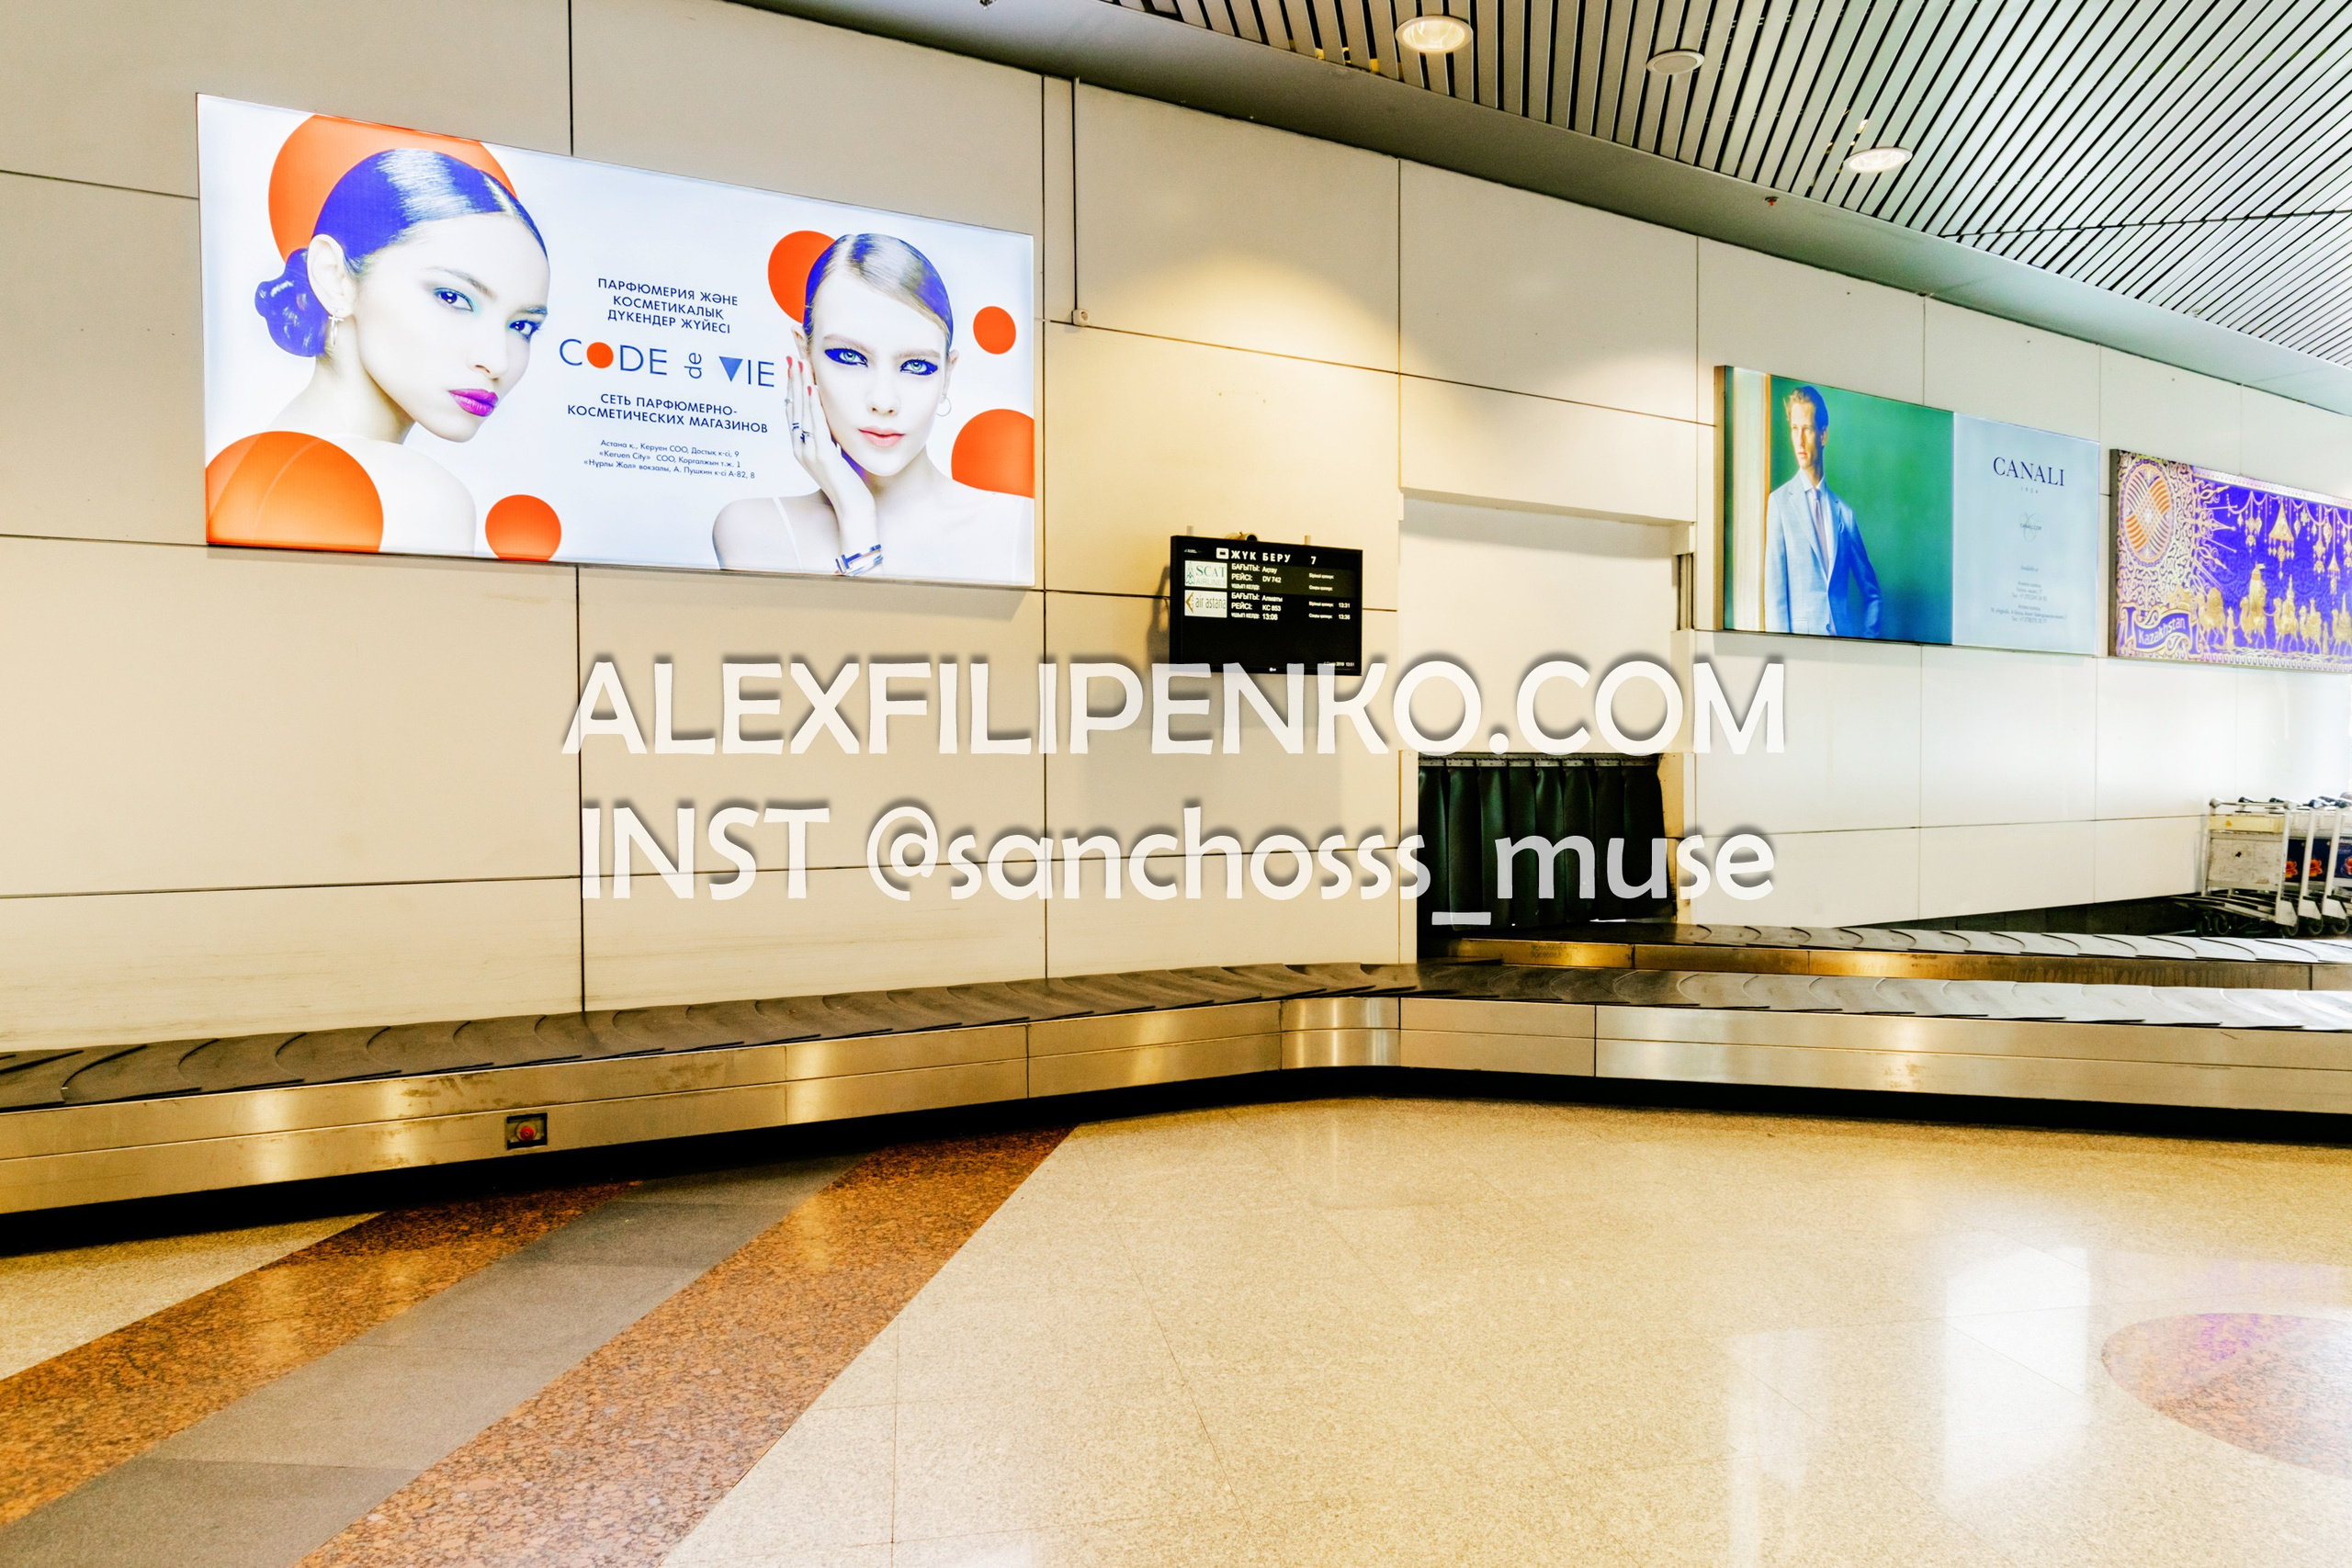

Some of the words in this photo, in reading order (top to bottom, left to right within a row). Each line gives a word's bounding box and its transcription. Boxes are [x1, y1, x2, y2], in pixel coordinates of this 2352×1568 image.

[598, 278, 695, 300] ПАРФЮМЕРИЯ
[700, 291, 739, 306] ЖӘНЕ
[613, 296, 724, 320] КОСМЕТИКАЛЫҚ
[607, 310, 676, 327] ДҮКЕНДЕР
[681, 318, 730, 333] ЖҮЙЕСІ
[600, 393, 631, 406] СЕТЬ
[636, 397, 738, 416] ПАРФЮМЕРНО-
[567, 404, 684, 425] КОСМЕТИЧЕСКИХ
[689, 416, 768, 434] МАГАЗИНОВ
[601, 439, 628, 448] Астана
[640, 443, 668, 452] Керуен
[691, 446, 717, 457] Достық
[684, 466, 713, 476] Пушкин
[1993, 457, 2064, 487] CANALI
[1231, 550, 1257, 561] ЖҮК
[1262, 552, 1291, 563] БЕРУ
[1310, 556, 1317, 565] 7
[1195, 564, 1227, 578] SCAT
[1195, 594, 1204, 609] air
[1205, 597, 1227, 610] astana
[2138, 617, 2186, 645] Kazakhstan
